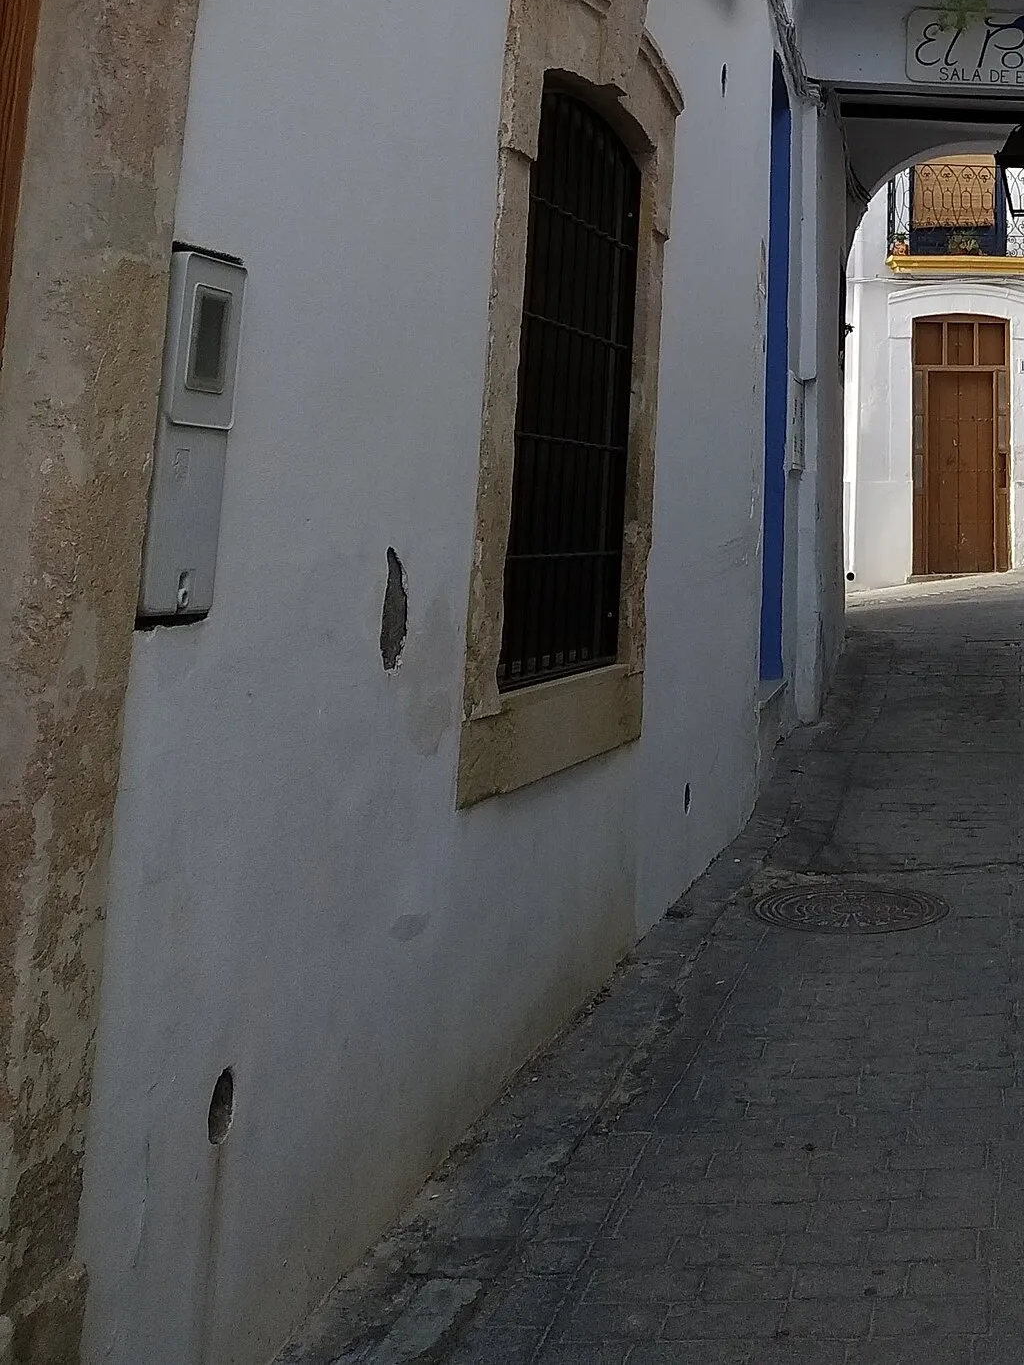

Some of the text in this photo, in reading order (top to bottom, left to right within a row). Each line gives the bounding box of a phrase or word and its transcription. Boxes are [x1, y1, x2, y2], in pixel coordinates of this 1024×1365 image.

[915, 22, 963, 67] El
[939, 66, 982, 82] SALA
[989, 69, 1010, 84] DE
